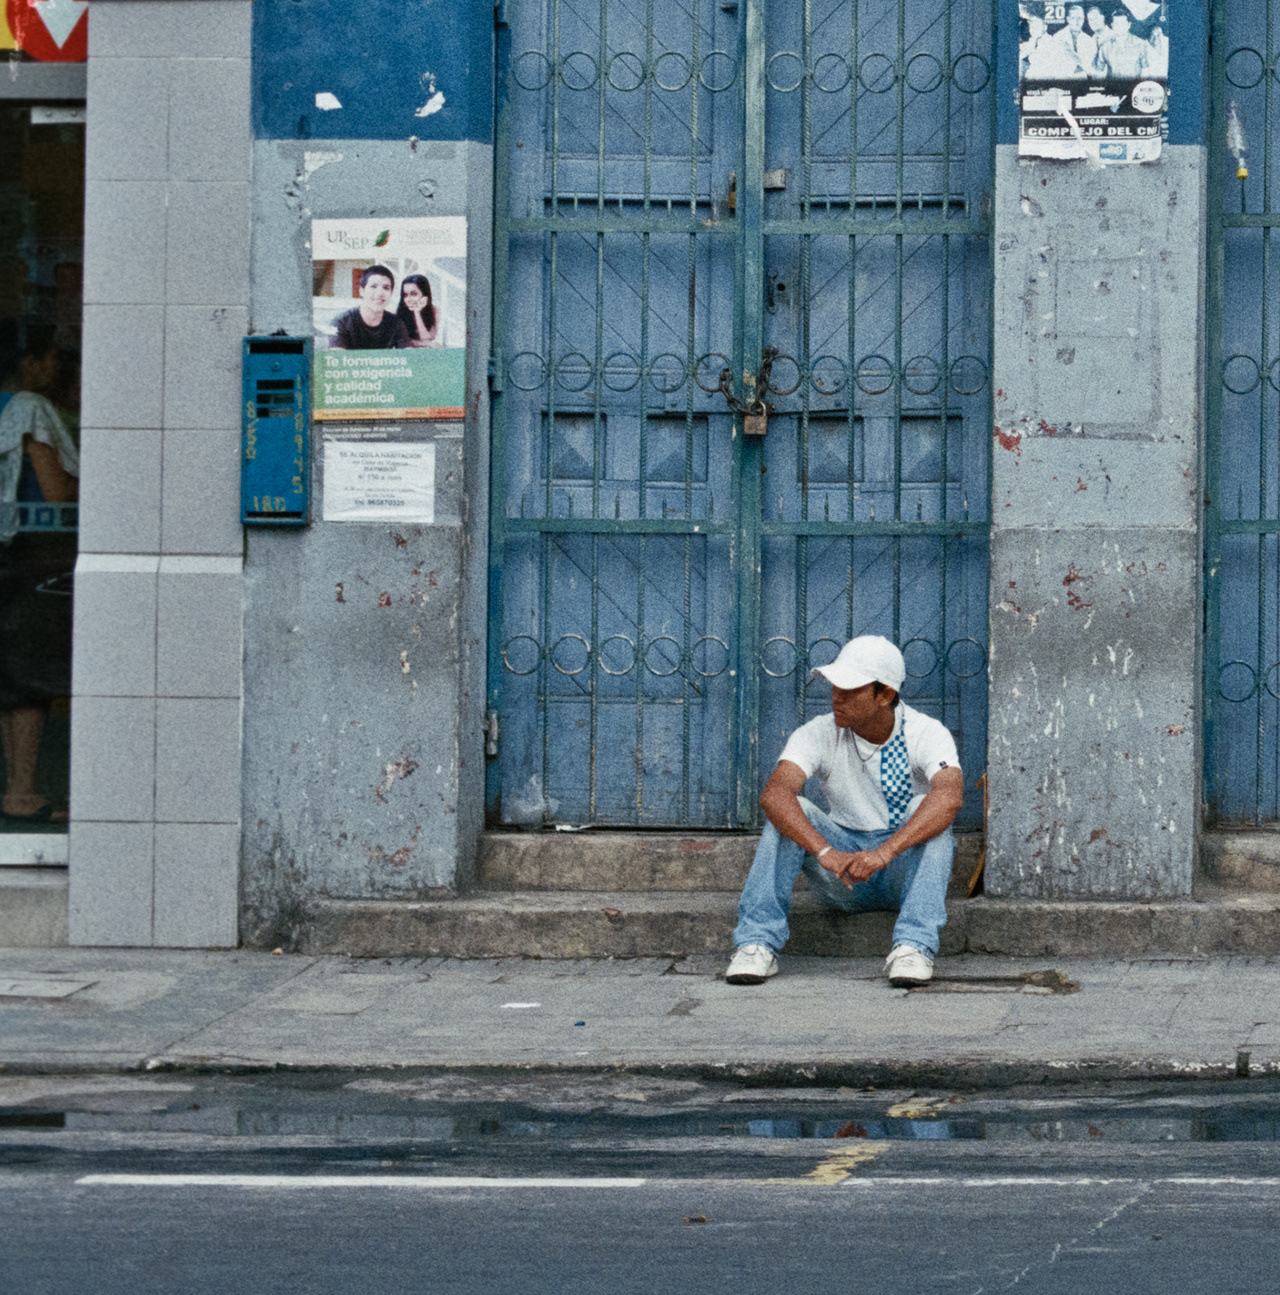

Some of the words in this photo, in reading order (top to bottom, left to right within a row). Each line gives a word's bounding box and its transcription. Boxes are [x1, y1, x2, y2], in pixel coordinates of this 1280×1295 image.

[1044, 7, 1065, 20] 20
[1107, 127, 1133, 136] DEL
[325, 356, 339, 367] Te
[343, 355, 407, 367] formamos
[325, 369, 348, 379] con
[352, 367, 413, 380] exigencia
[324, 382, 332, 393] y
[335, 380, 382, 392] calidad
[325, 392, 395, 404] académica
